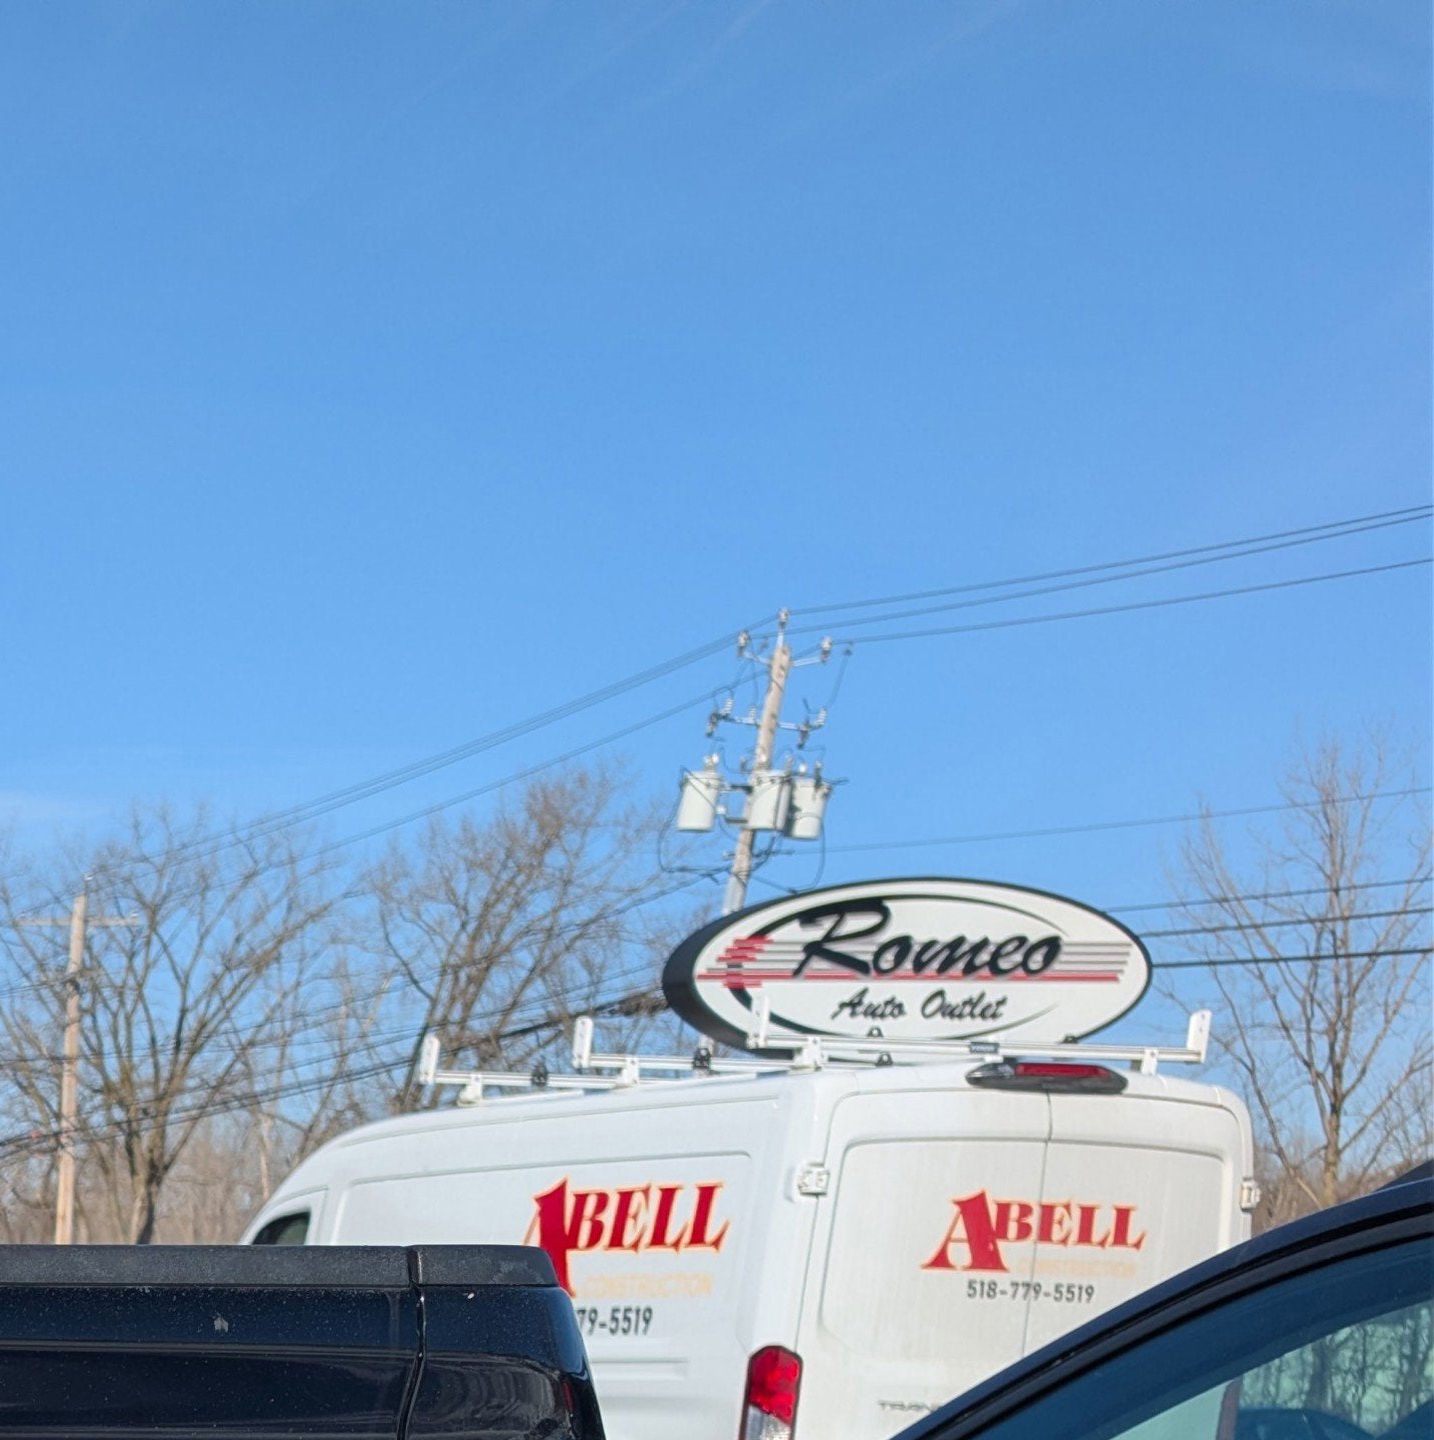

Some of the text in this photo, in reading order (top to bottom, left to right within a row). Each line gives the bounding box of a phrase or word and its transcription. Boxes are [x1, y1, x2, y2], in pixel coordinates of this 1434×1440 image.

[792, 898, 1062, 977] Romeo
[830, 986, 1008, 1021] Auto Outlet
[920, 1188, 1147, 1274] ABELL
[966, 1278, 1095, 1304] 518-779-5519
[577, 1304, 654, 1337] 79-5519
